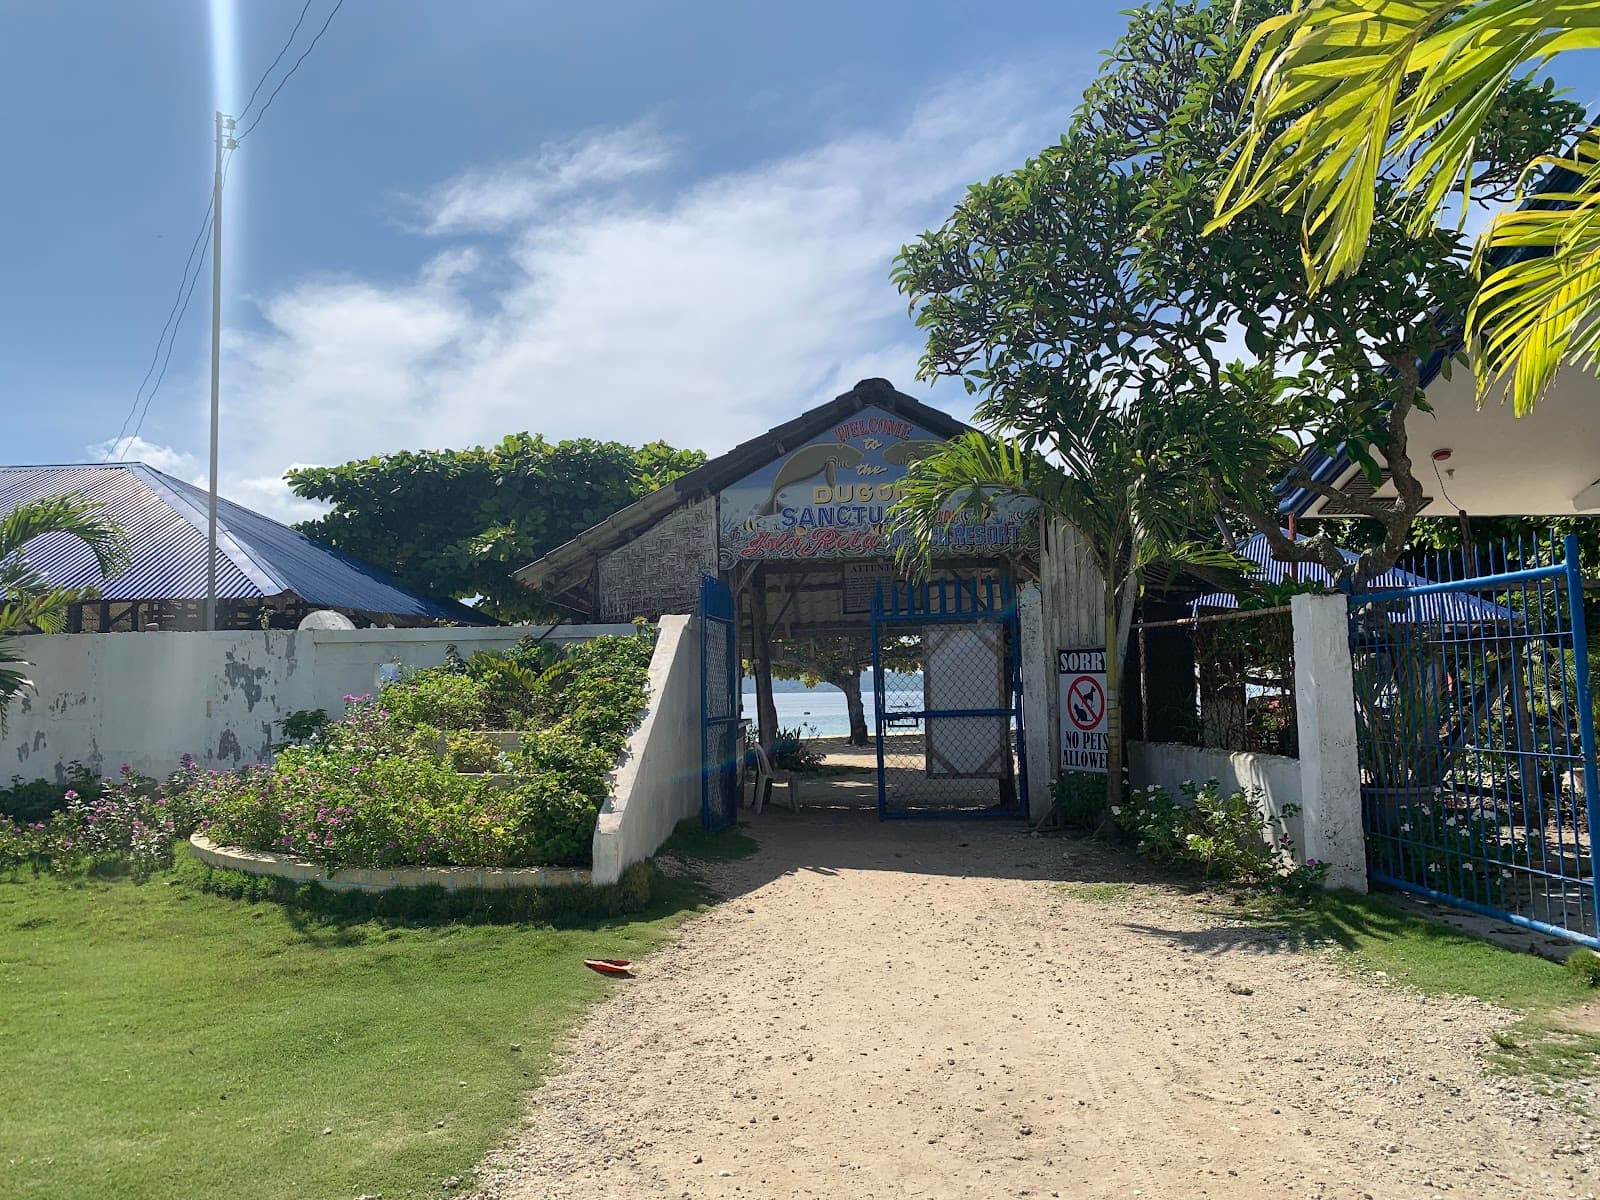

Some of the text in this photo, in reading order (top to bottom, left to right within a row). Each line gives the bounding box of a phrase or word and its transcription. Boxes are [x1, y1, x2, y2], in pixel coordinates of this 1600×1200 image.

[834, 415, 913, 441] WELCOME
[863, 437, 884, 450] to
[856, 463, 888, 476] the
[800, 527, 877, 557] Reta
[953, 525, 1019, 545] RESORT
[1065, 730, 1079, 749] NO
[1063, 750, 1108, 769] ALLOWE
